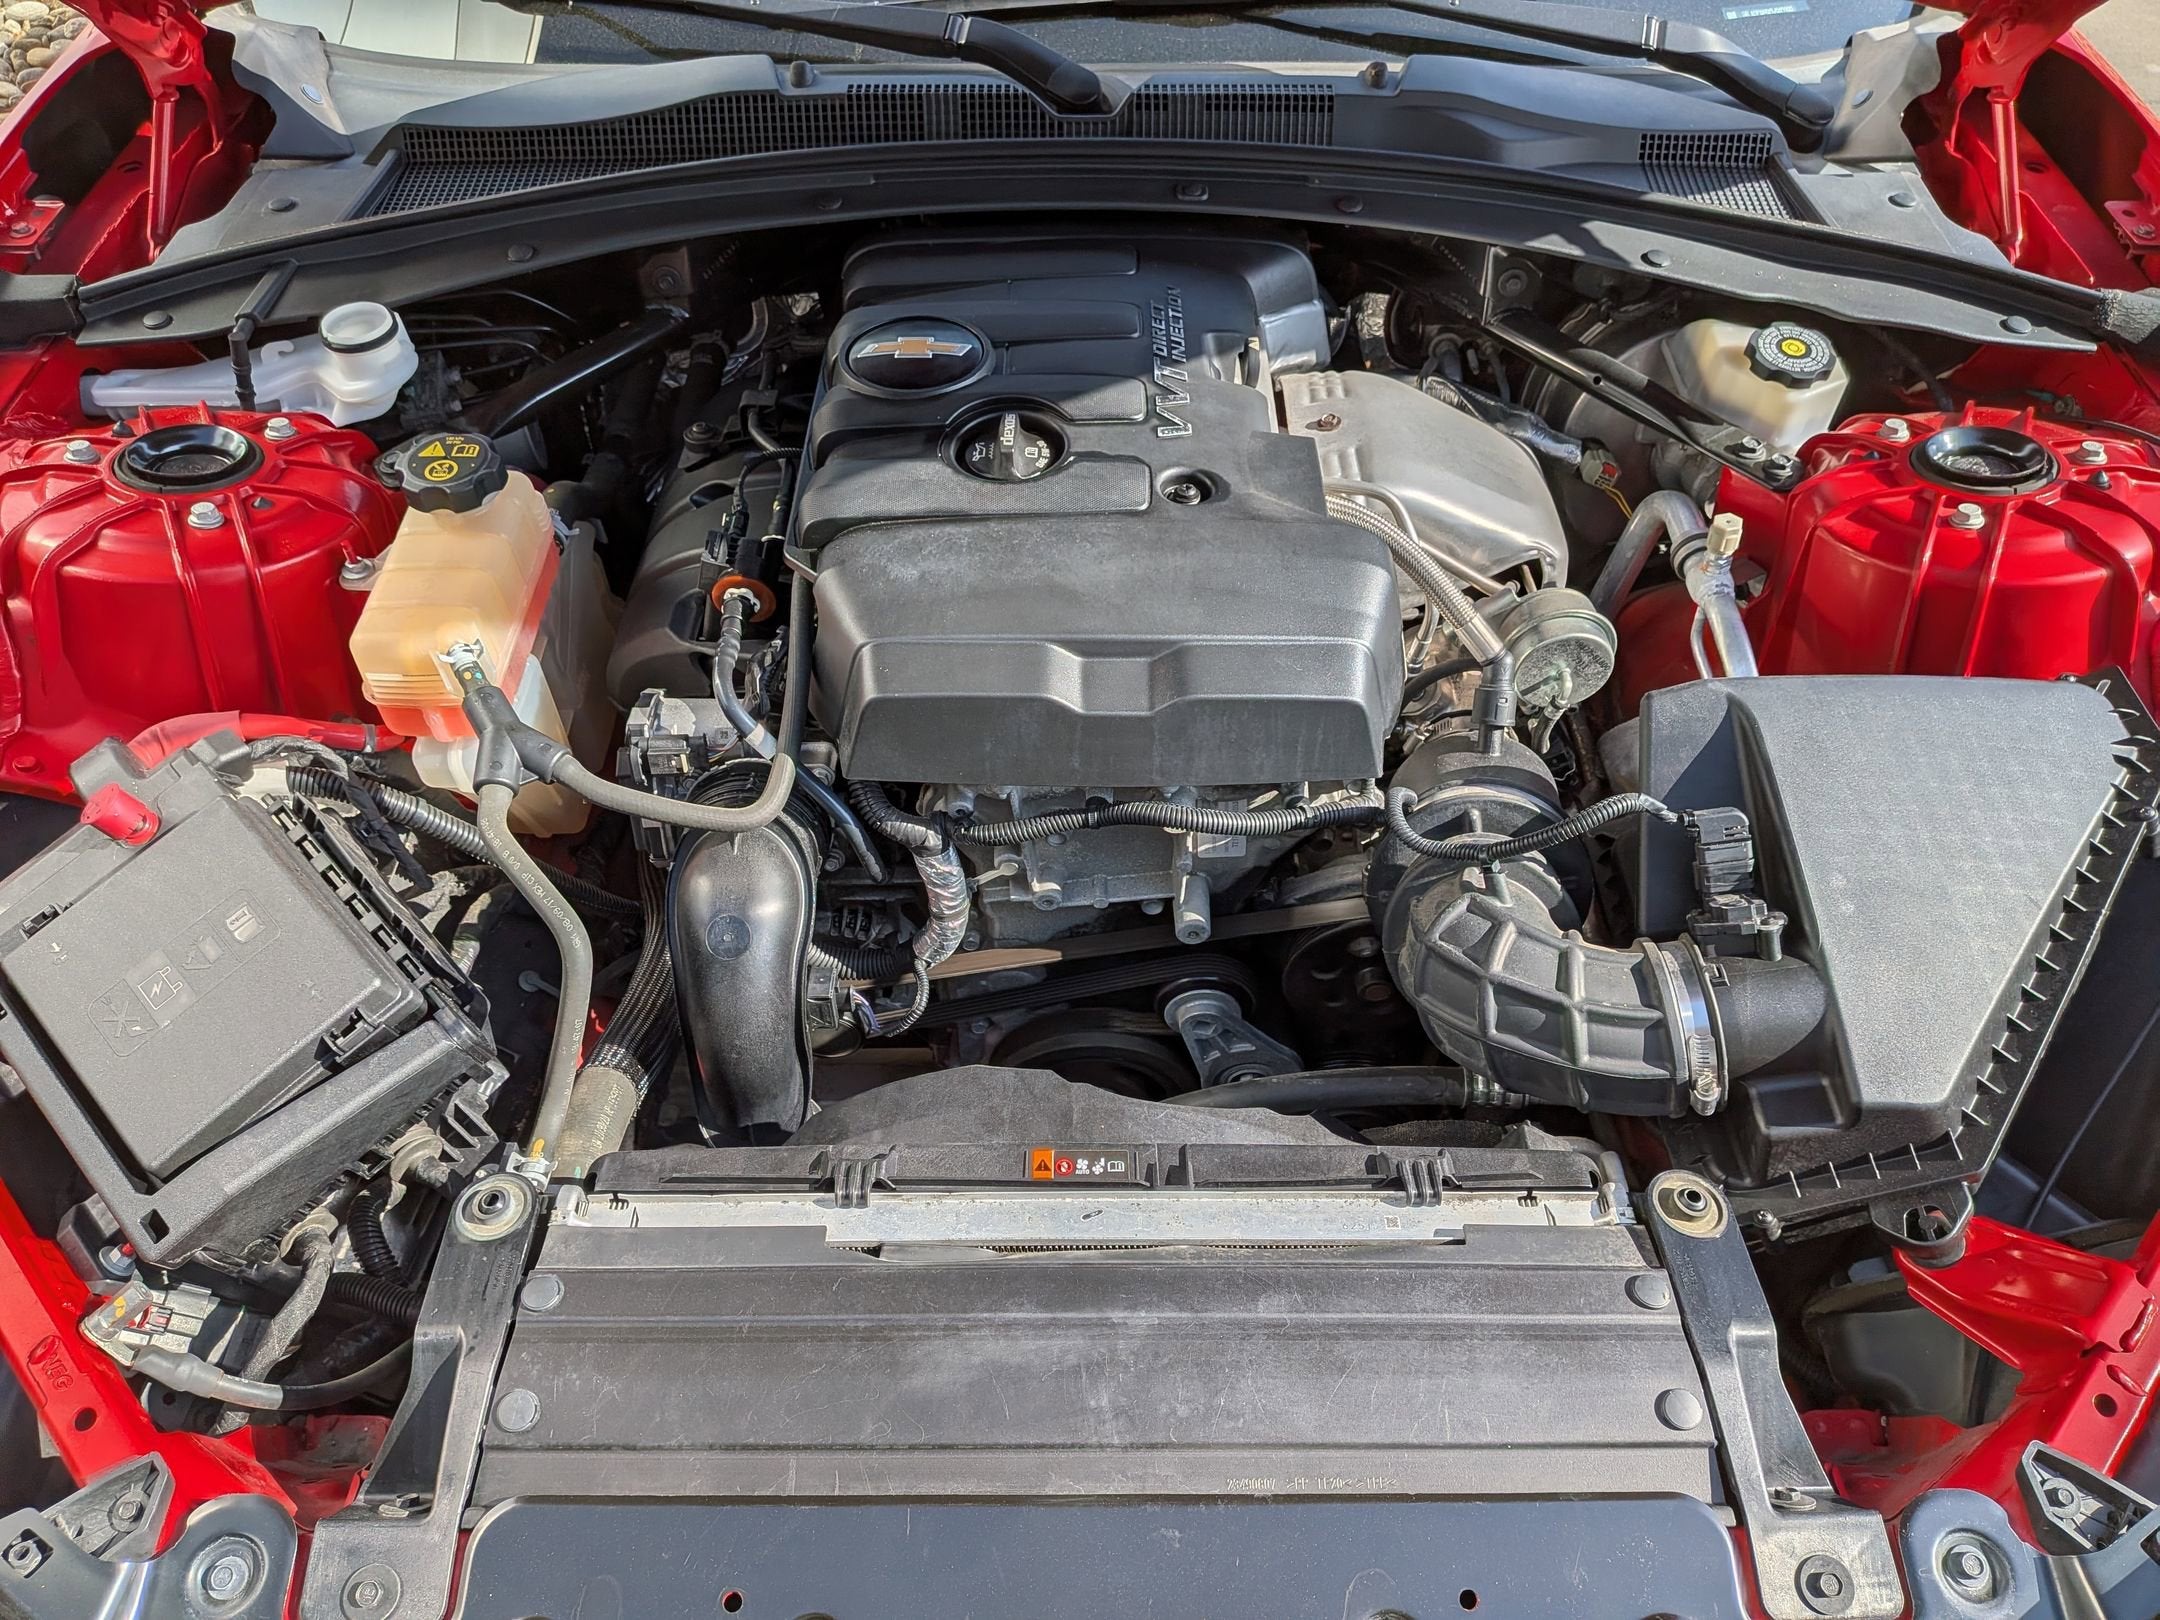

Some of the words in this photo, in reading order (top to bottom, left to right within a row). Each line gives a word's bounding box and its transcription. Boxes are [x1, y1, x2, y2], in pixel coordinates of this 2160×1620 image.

[1151, 301, 1168, 357] DIRECT
[1168, 285, 1187, 363] INJECTION
[1154, 356, 1193, 438] VVT
[1000, 413, 1016, 446] dexos
[532, 882, 547, 898] MEX
[543, 897, 574, 933] 08/09/17
[42, 1353, 74, 1392] NEG
